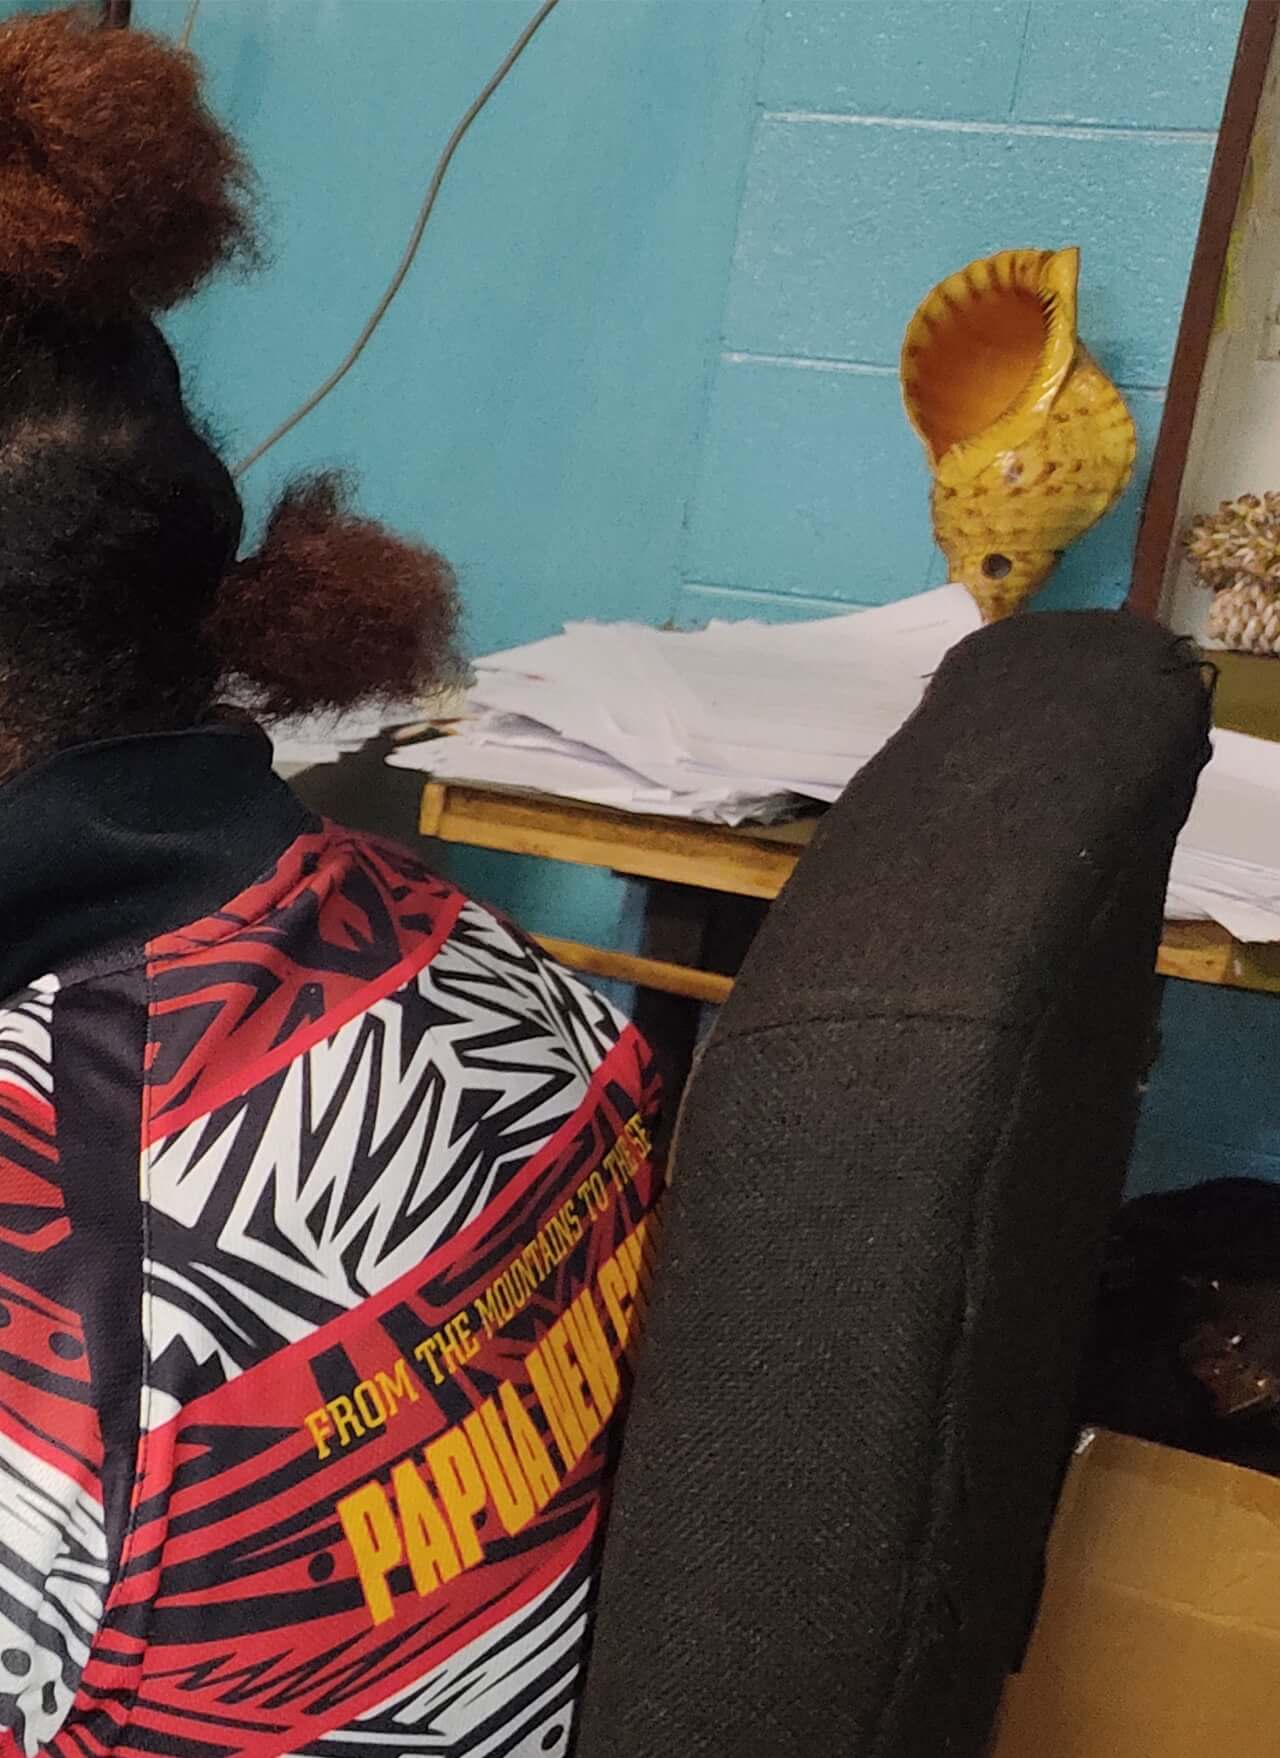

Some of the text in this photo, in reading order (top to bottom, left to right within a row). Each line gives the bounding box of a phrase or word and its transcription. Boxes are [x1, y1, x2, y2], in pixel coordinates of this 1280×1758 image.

[305, 1362, 420, 1460] FROM
[415, 1318, 479, 1387] THE
[476, 1200, 583, 1338] MOUNTAINS
[577, 1171, 608, 1222] TO
[603, 1134, 639, 1193] THE
[337, 1382, 562, 1627] PAPUA
[525, 1286, 621, 1474] NEW
